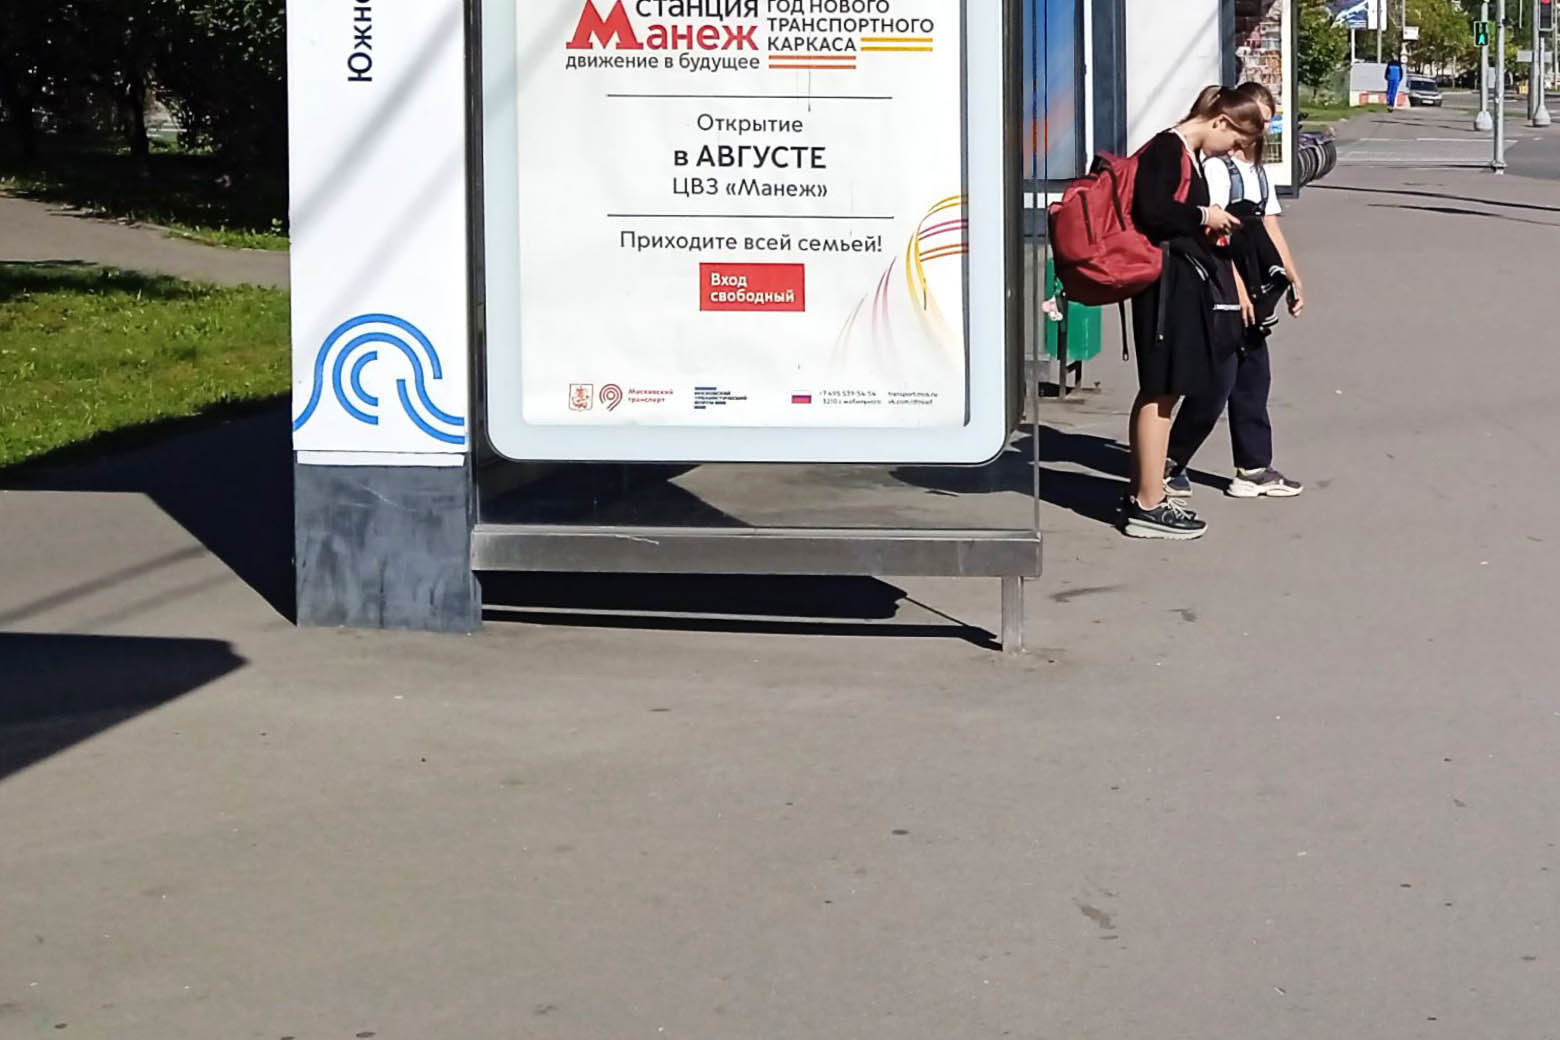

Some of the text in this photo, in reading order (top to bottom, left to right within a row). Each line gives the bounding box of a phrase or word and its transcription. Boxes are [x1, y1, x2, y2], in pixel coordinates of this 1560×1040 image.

[766, 17, 934, 34] ТРАНСПОРТНОГО
[767, 36, 857, 52] КАРКАСА
[565, 52, 760, 72] движение в будущее
[697, 113, 803, 136] Открытие
[674, 144, 827, 169] в АВГУСТЕ
[673, 177, 828, 198] ЦВЗ «Манеж»
[620, 230, 882, 253] Приходите всей семьей!
[711, 272, 747, 288] Вход
[711, 289, 794, 304] свободный
